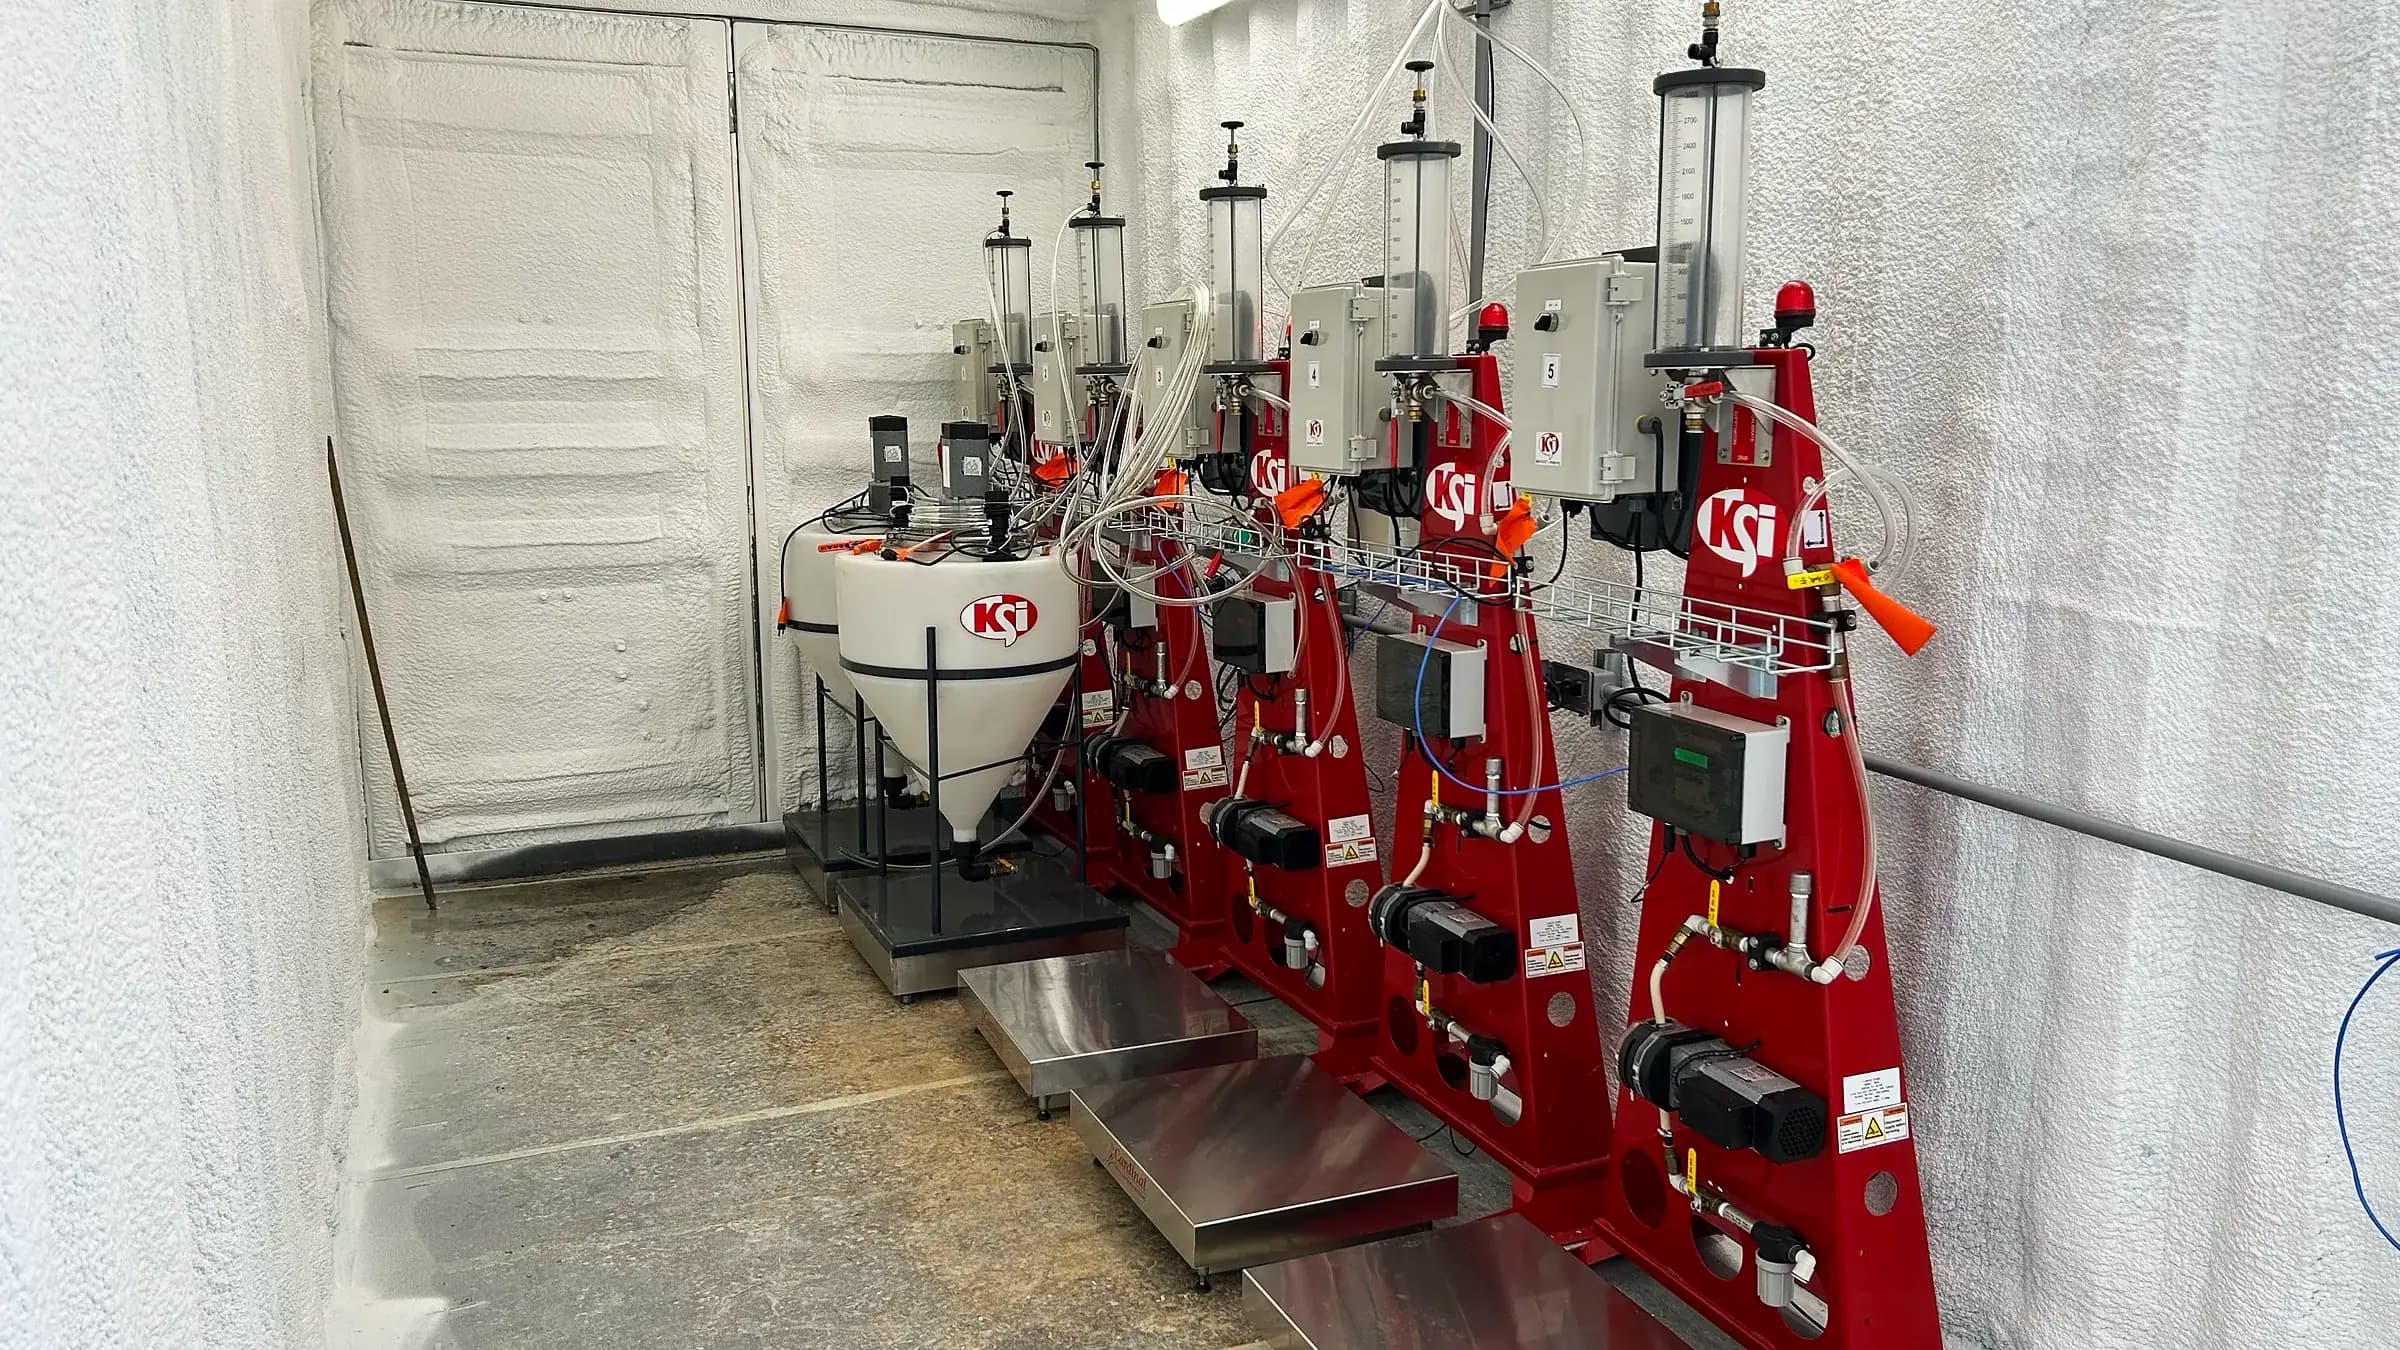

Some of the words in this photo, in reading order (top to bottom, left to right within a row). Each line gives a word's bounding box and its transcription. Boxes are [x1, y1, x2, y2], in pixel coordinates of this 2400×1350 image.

[1311, 368, 1317, 381] 4
[1548, 363, 1554, 379] 5
[1256, 455, 1286, 497] KSi
[1433, 469, 1476, 532] KSi
[1709, 496, 1777, 578] KSi
[974, 601, 1028, 648] KSi
